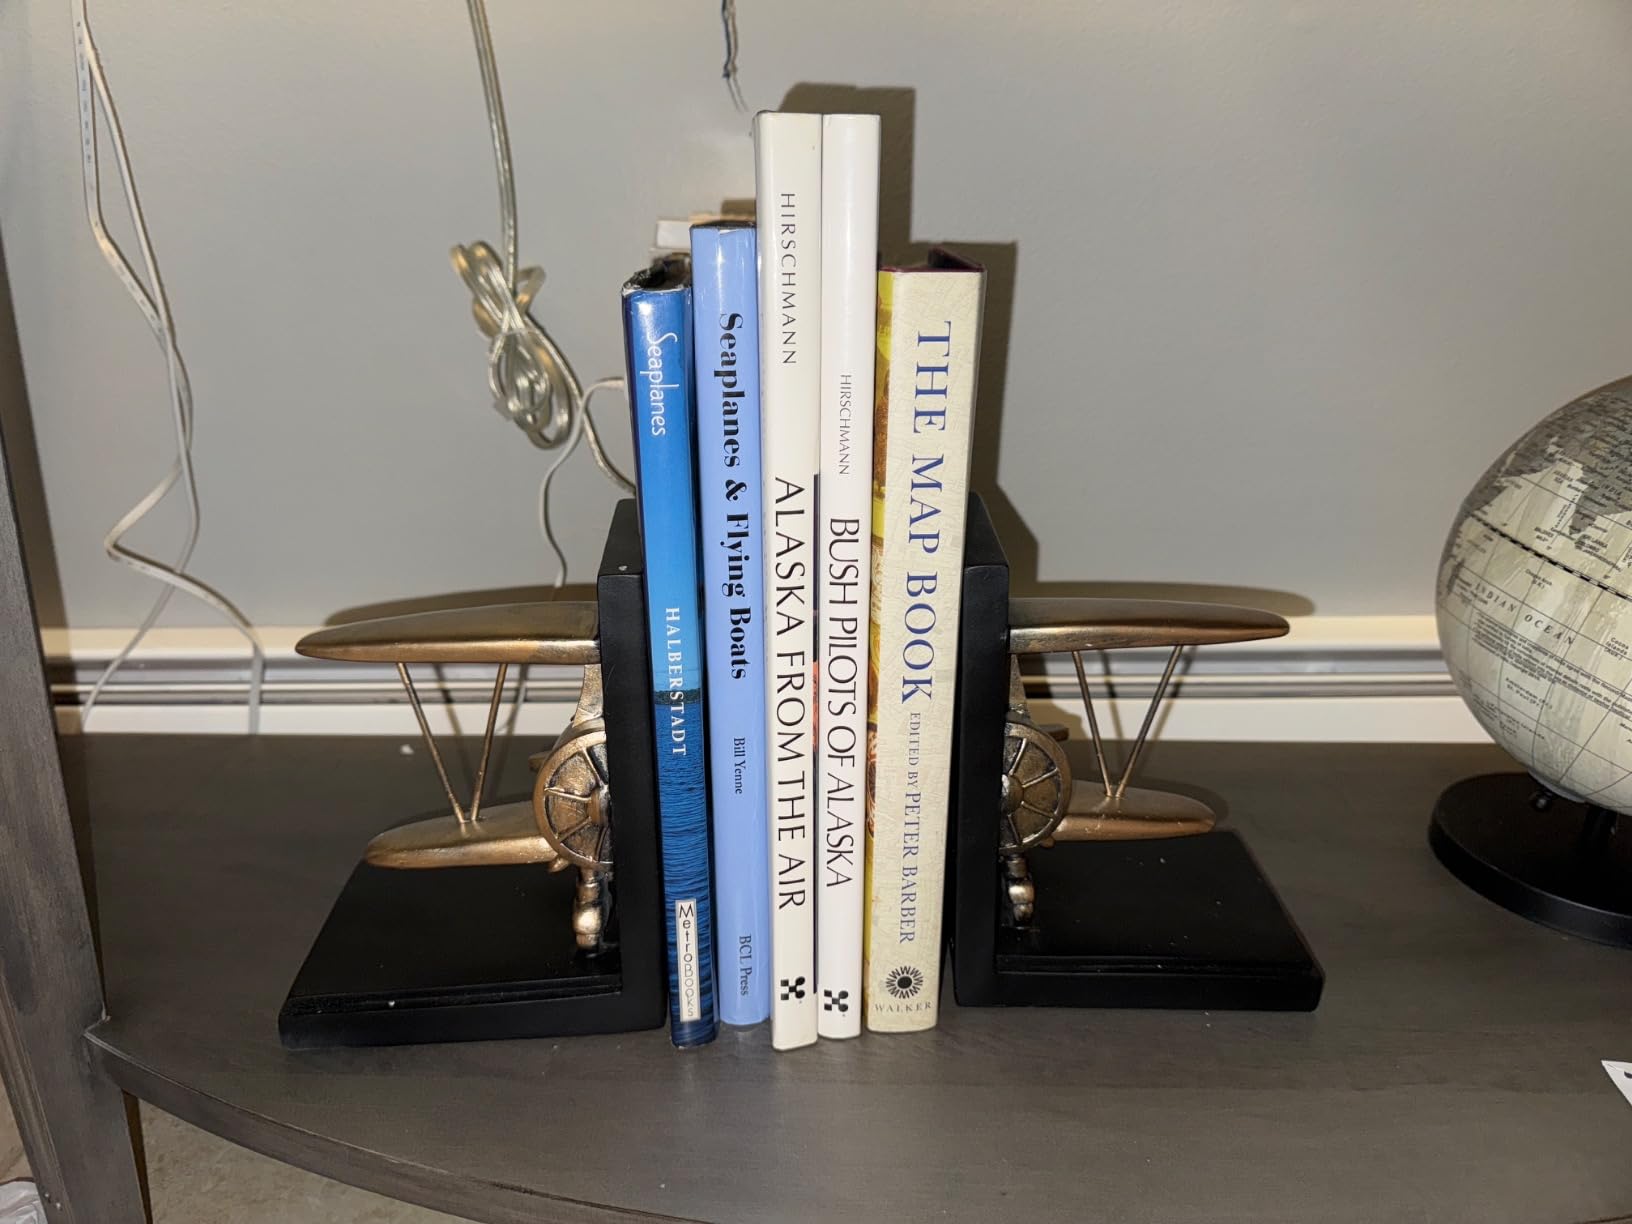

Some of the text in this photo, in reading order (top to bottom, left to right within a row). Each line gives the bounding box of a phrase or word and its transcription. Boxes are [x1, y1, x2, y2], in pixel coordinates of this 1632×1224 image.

[780, 192, 797, 365] HIRSCHMANN
[640, 331, 678, 438] Seaplanes
[839, 374, 852, 476] HIRSCHMANN
[714, 312, 752, 680] Seaplanes & Flying Boats
[901, 319, 951, 703] THE MAP BOOK
[664, 606, 687, 756] HALBERSTADT
[1473, 582, 1517, 613] INDIAN
[1523, 612, 1576, 646] OCEAN
[733, 737, 746, 795] Bill Yenne
[774, 476, 807, 910] ALASKA FROM THE AIR
[826, 517, 860, 888] BUSH PILOTS OF ALASKA
[899, 712, 922, 944] EDITED BY PETER BARBER
[738, 935, 752, 996] BCL Press
[874, 1001, 932, 1013] WALKER
